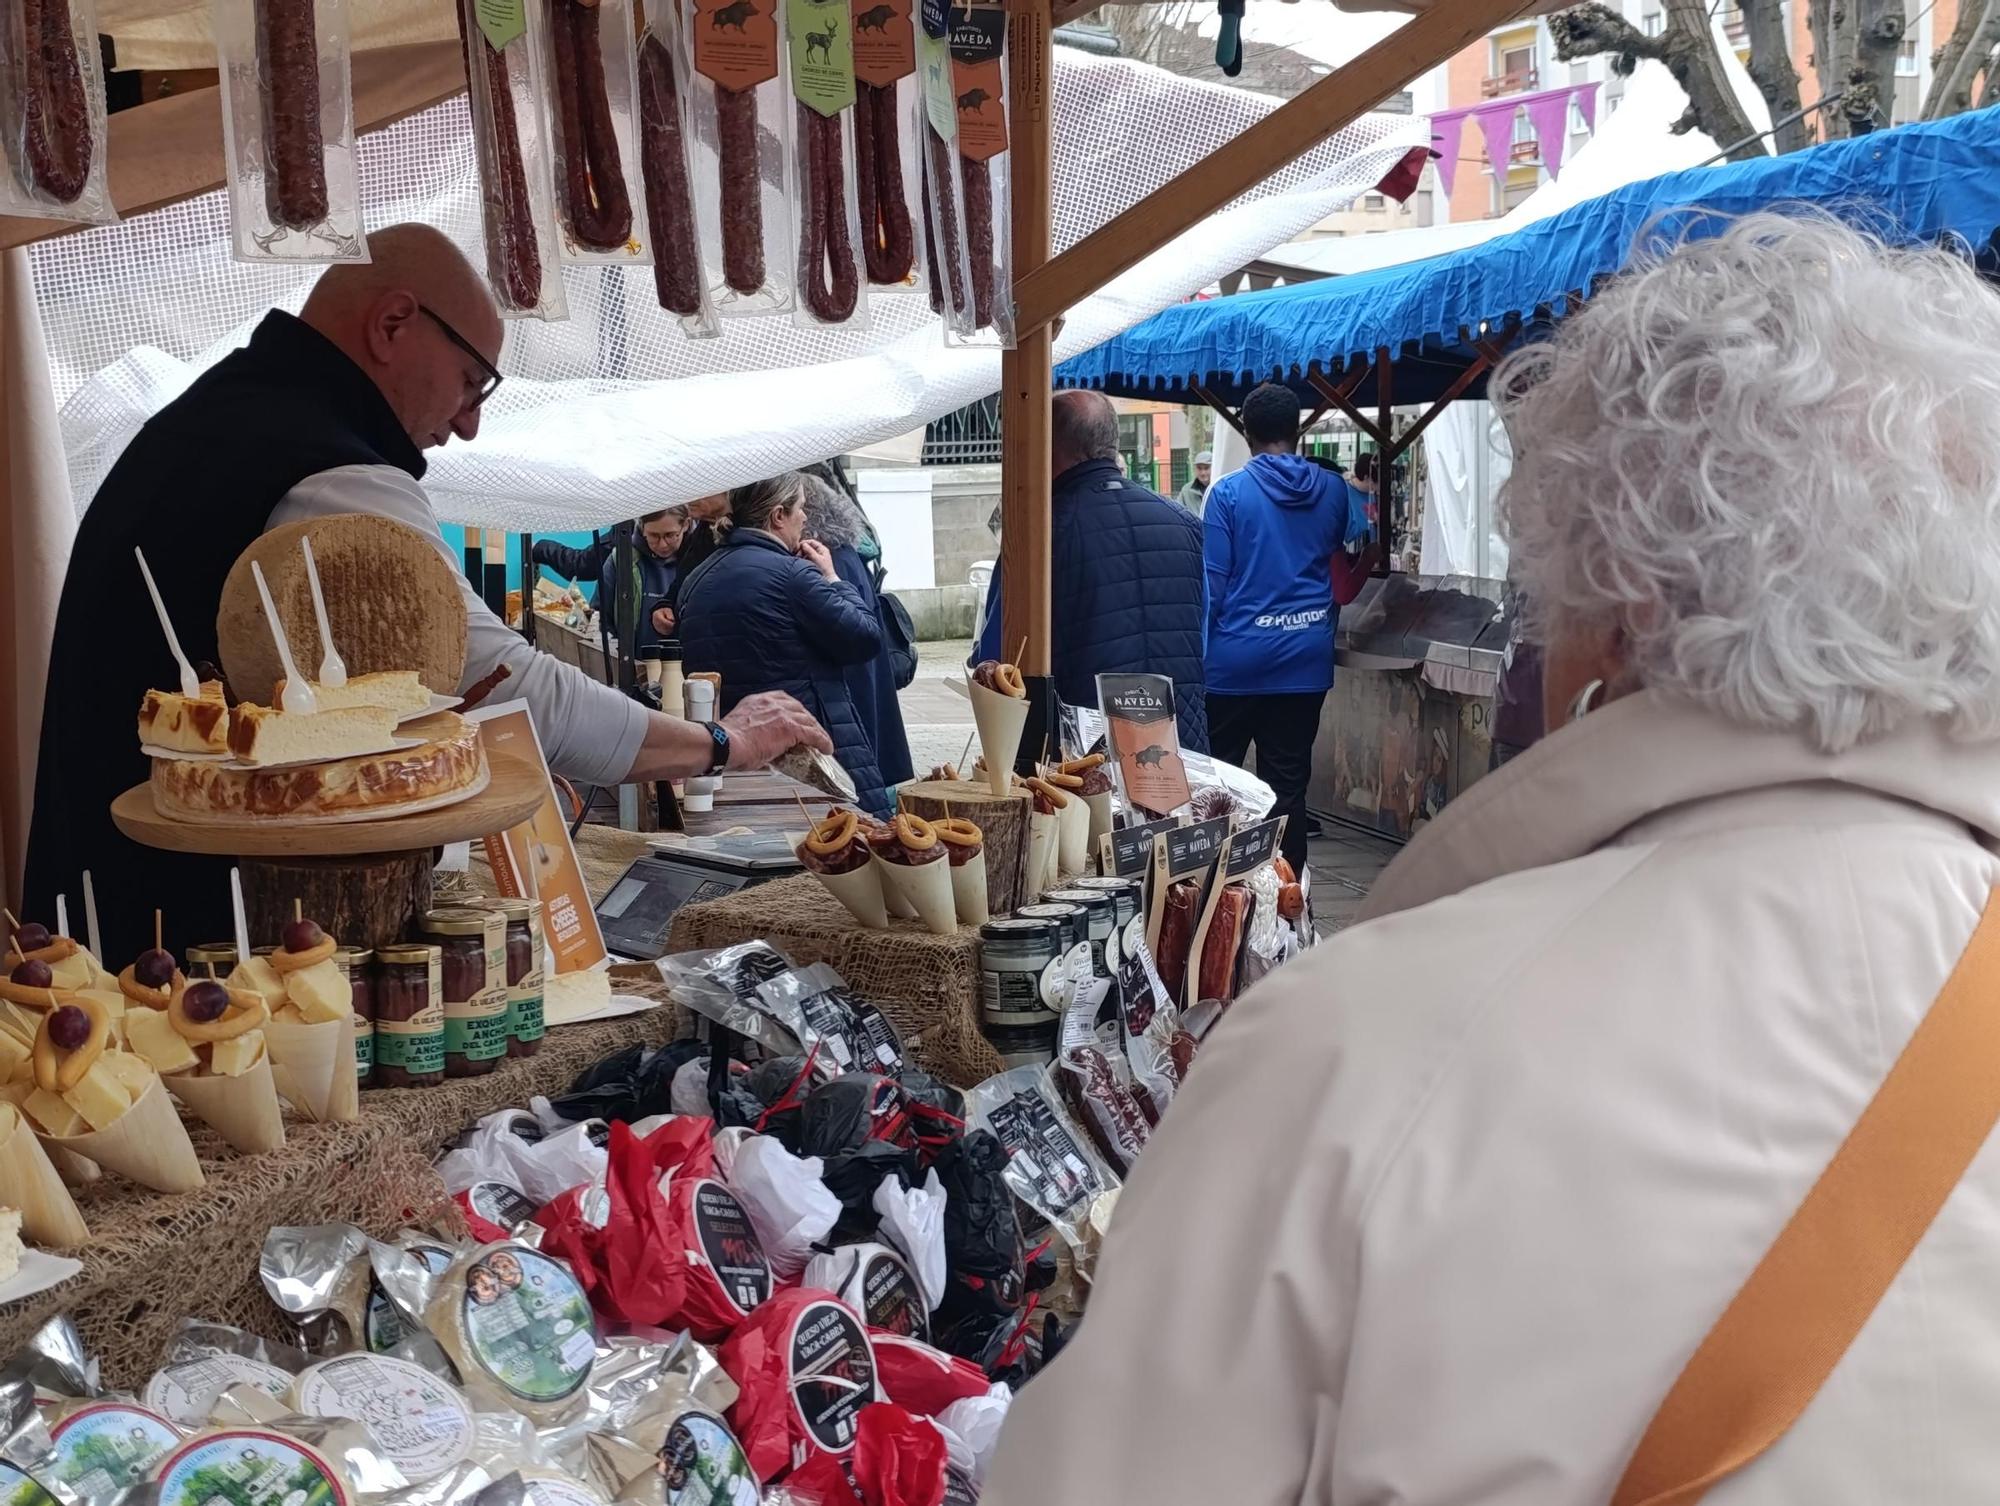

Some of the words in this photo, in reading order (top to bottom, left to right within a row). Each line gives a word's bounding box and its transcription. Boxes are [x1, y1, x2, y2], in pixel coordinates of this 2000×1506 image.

[1114, 697, 1162, 706] NAVEDA
[1189, 838, 1210, 853] NAVEDA
[798, 1323, 820, 1345] QUESO
[818, 1310, 839, 1330] VIEJO
